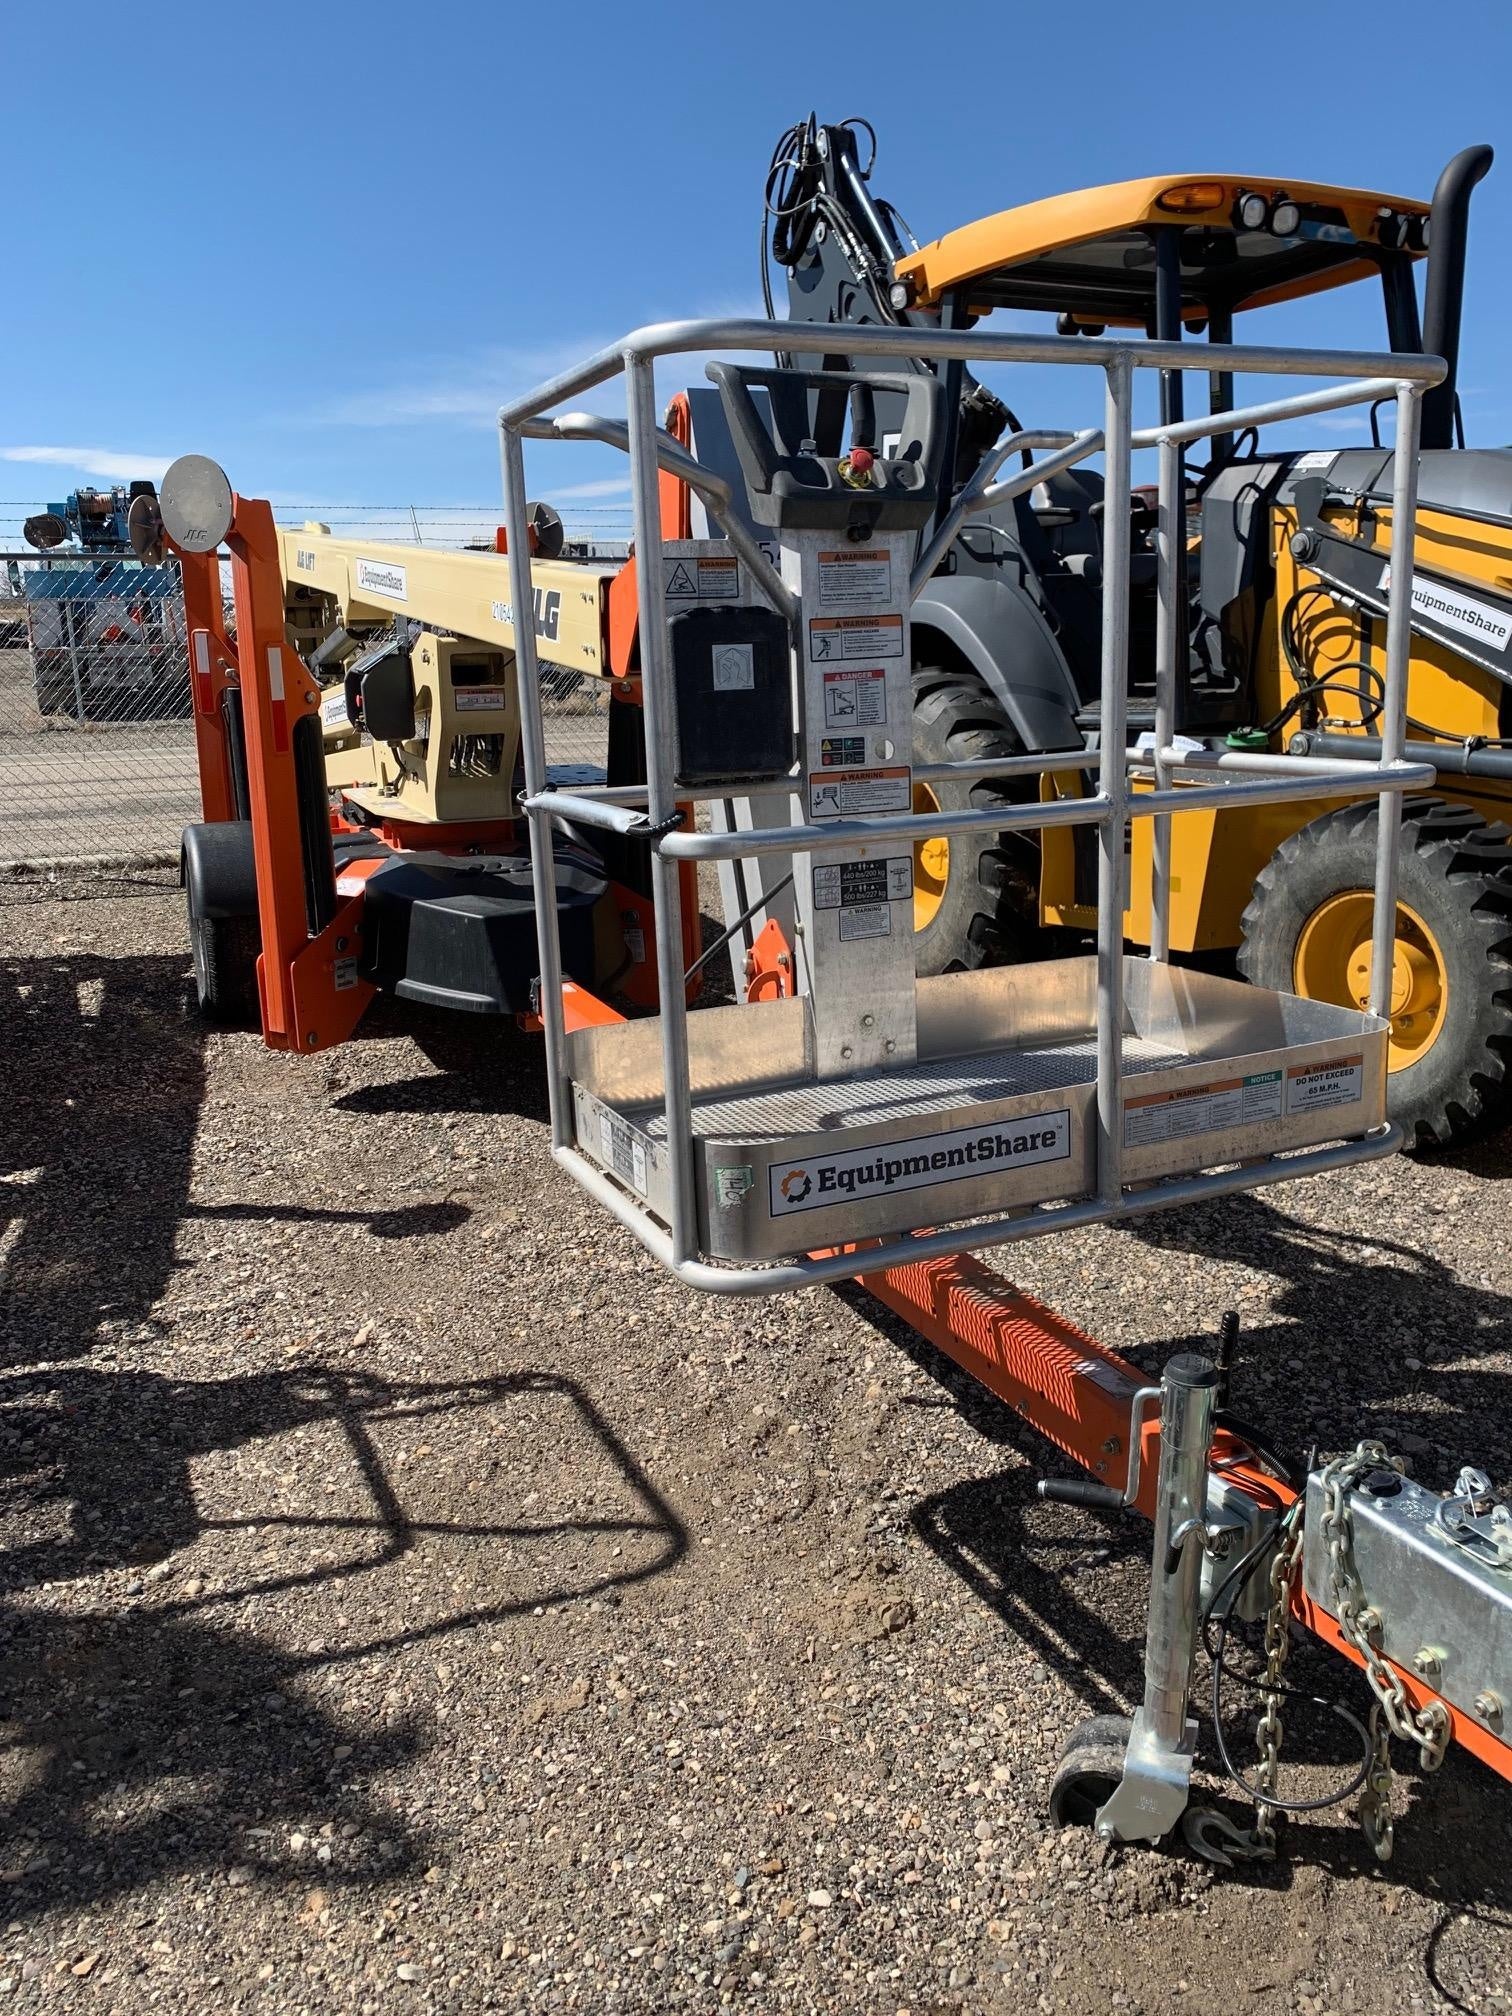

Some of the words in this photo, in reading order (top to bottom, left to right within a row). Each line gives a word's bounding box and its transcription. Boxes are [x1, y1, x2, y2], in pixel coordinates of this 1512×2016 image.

[183, 529, 208, 542] JLG
[842, 552, 878, 562] WARNING
[361, 565, 403, 591] EquipmentShare
[531, 587, 561, 641] LG
[1414, 590, 1507, 638] uipmentShare
[843, 619, 880, 628] WARNING
[842, 671, 873, 680] DANGER
[848, 771, 884, 781] WARNING
[854, 906, 882, 914] WARNING
[1312, 1060, 1348, 1073] WARNING
[1250, 1073, 1276, 1084] NOTICE
[1296, 1076, 1307, 1086] DO
[1308, 1073, 1325, 1083] NOT
[1325, 1068, 1355, 1080] EXCEED
[1176, 1086, 1210, 1099] WARNING
[1308, 1087, 1318, 1095] 65
[1319, 1083, 1341, 1093] M.P.H.
[817, 1126, 1057, 1193] EquipmentShare
